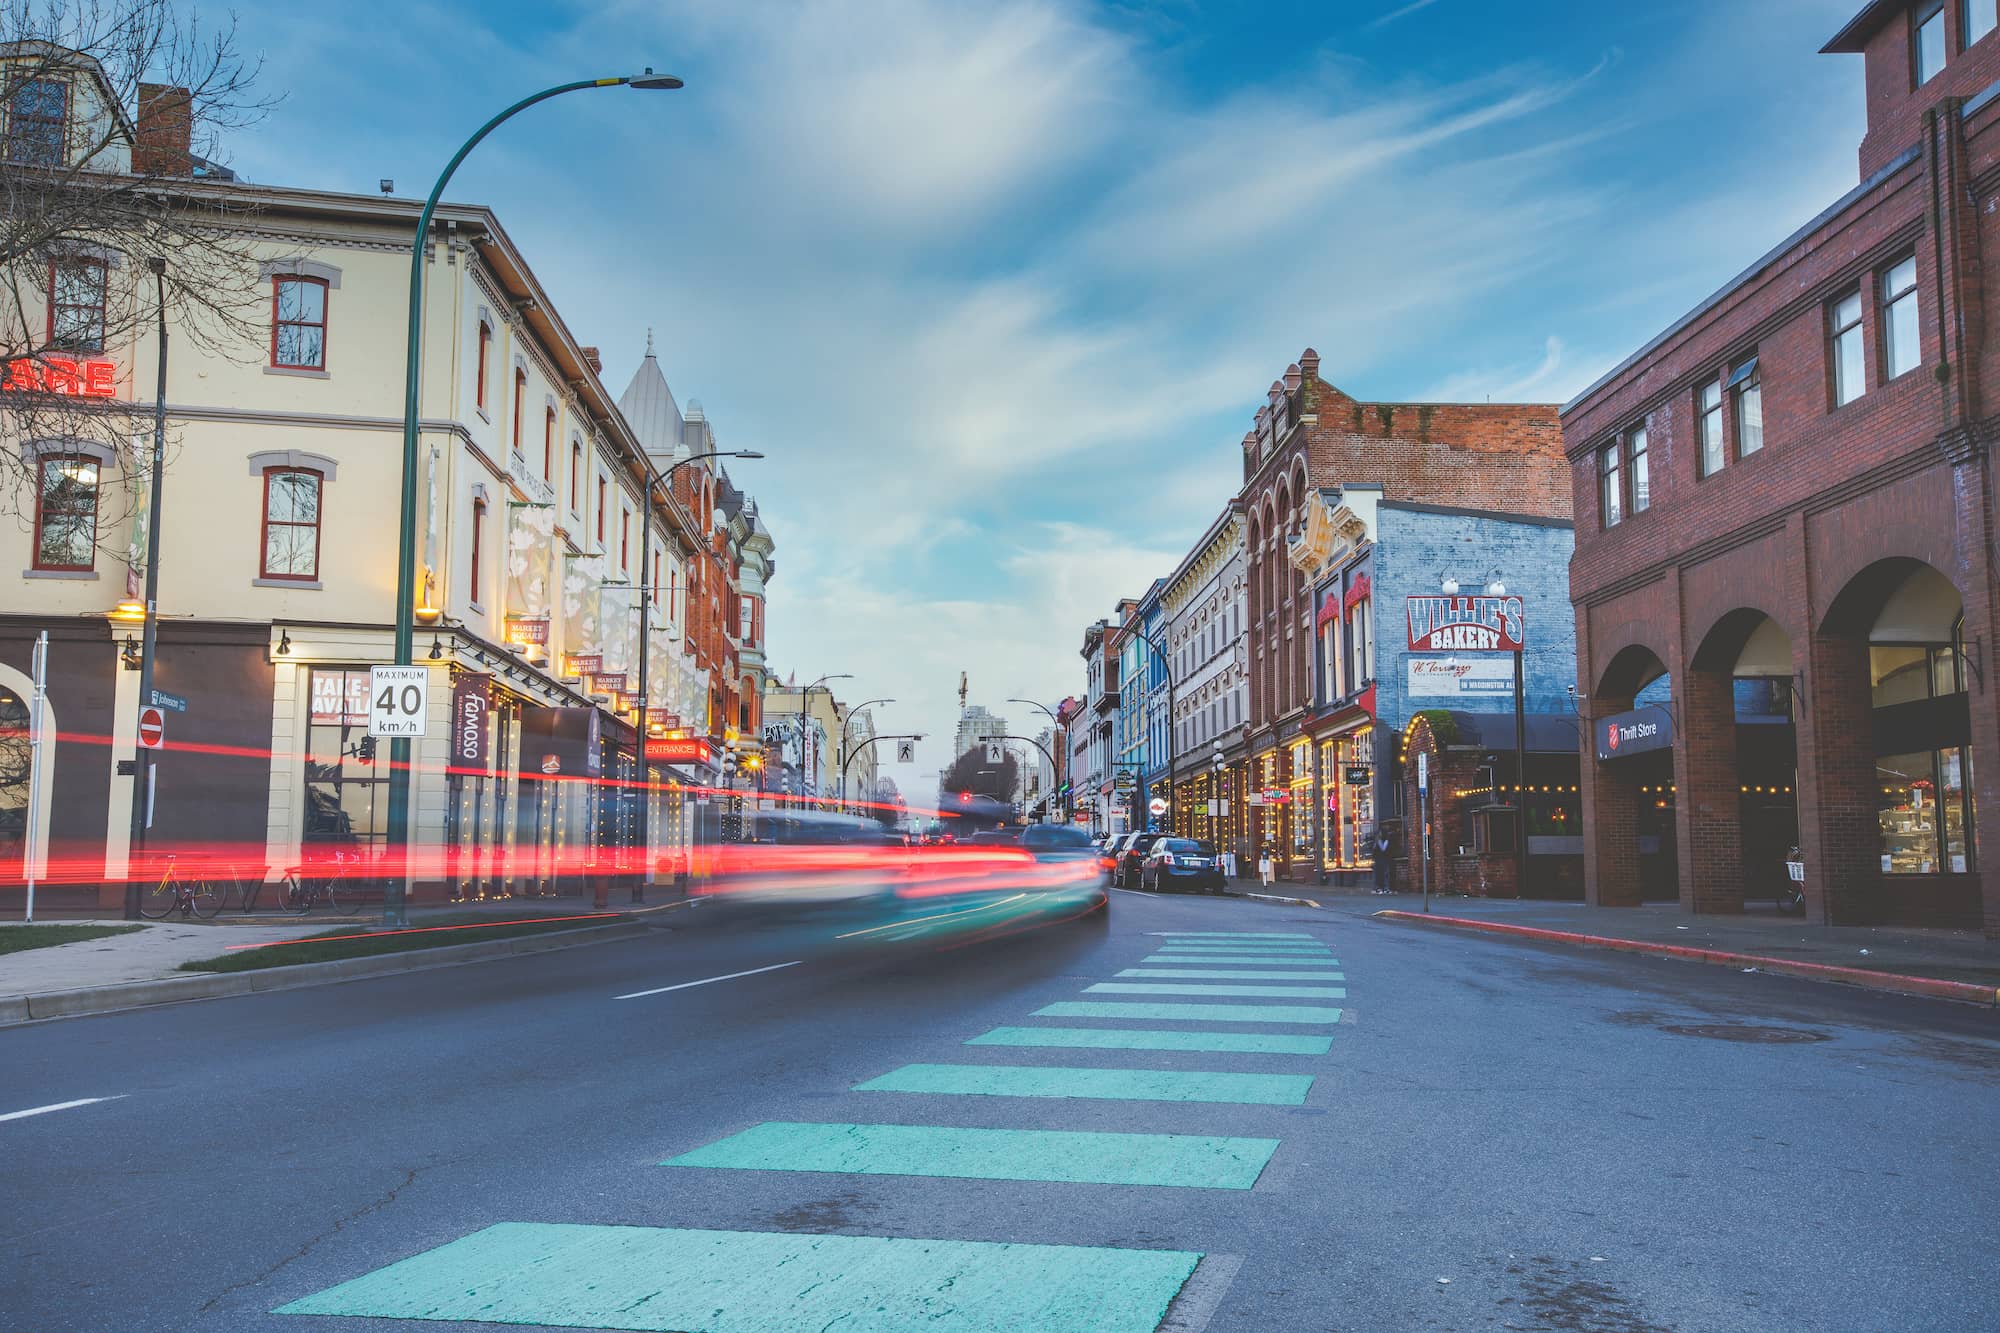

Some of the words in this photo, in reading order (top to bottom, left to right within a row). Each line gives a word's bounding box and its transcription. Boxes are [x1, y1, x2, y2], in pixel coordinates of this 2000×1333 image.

[1408, 598, 1522, 644] WILLIE'S
[1430, 625, 1500, 649] BAKERY
[376, 671, 424, 679] MAXIMUM
[1426, 661, 1472, 677] Terrzzo
[313, 678, 369, 696] TAKE-
[376, 685, 421, 715] 40
[379, 721, 417, 732] km/h
[1620, 725, 1638, 741] Thrift
[1638, 723, 1657, 738] Store
[647, 745, 693, 753] ENTRANCE
